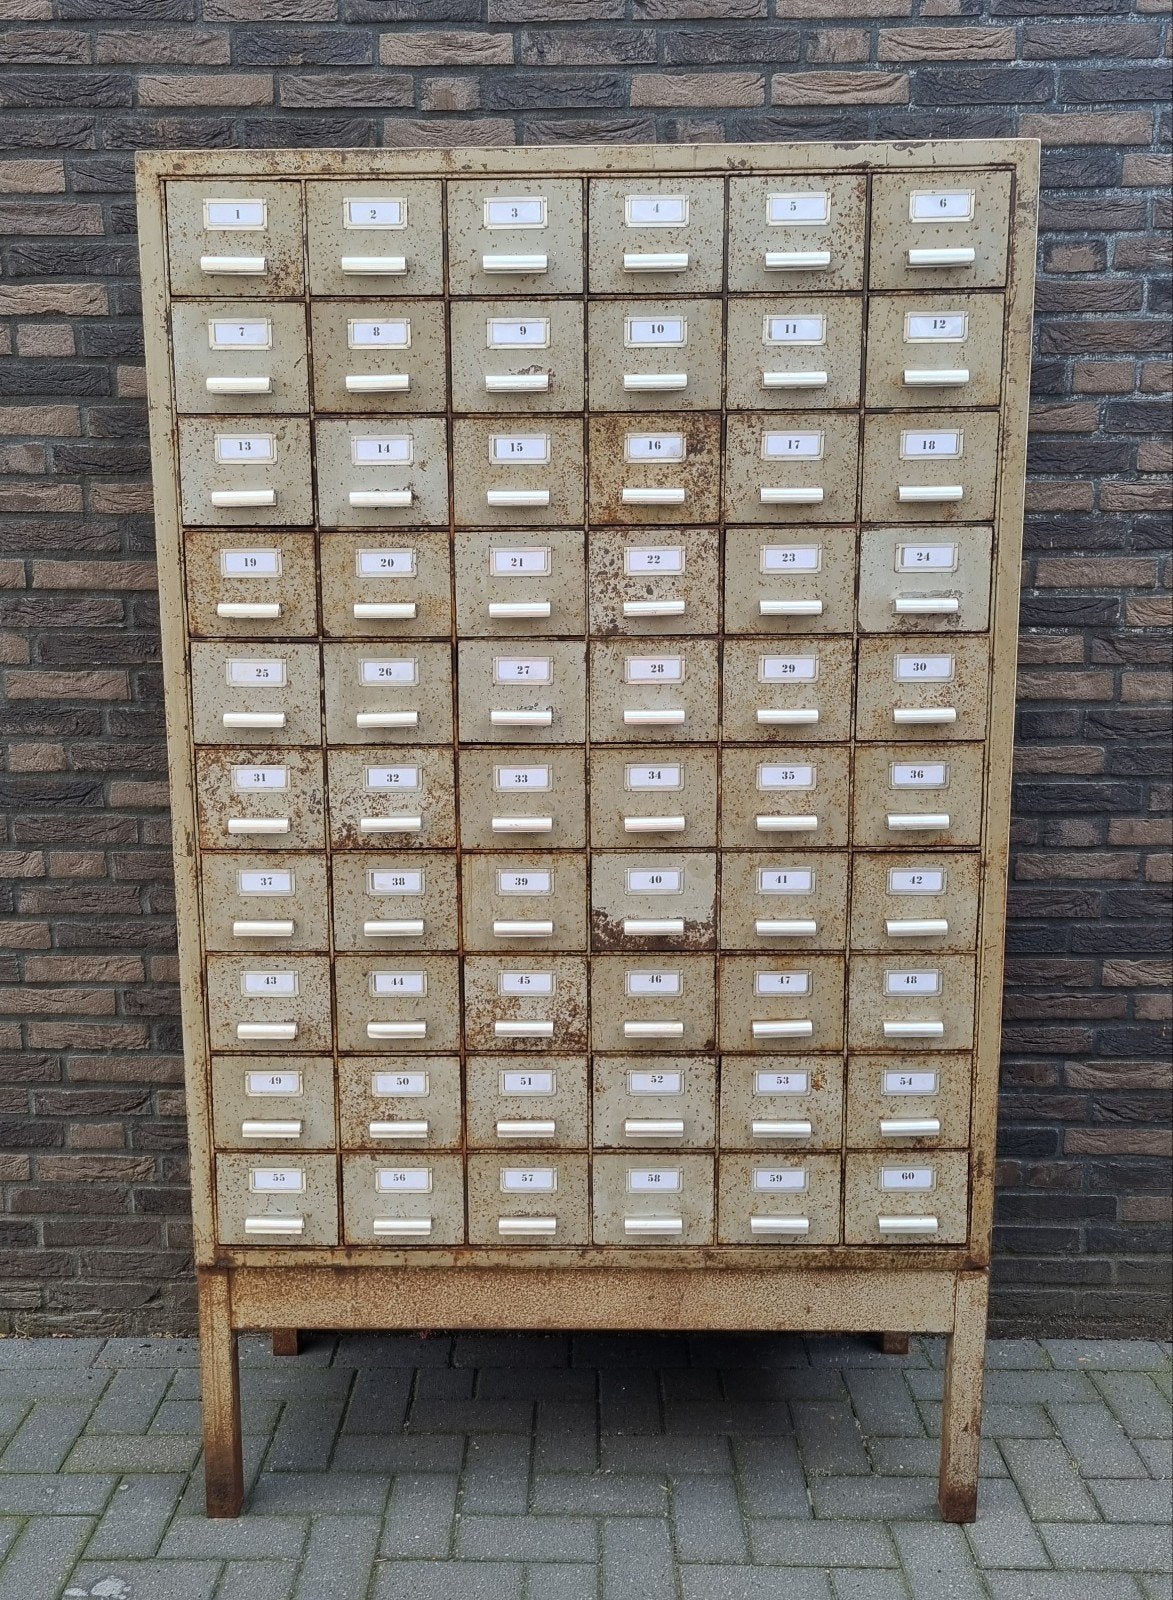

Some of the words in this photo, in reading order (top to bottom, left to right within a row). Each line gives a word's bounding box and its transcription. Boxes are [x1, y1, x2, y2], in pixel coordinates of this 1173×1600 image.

[790, 201, 797, 211] 5
[939, 198, 947, 208] 6
[235, 209, 242, 220] 1
[369, 209, 377, 220] 2
[511, 207, 519, 218] 3
[651, 324, 665, 334] 10
[785, 323, 797, 334] 11
[932, 319, 947, 330] 12
[238, 326, 245, 337] 7
[373, 326, 381, 337] 8
[519, 325, 527, 336] 9
[238, 441, 252, 451] 13
[377, 443, 391, 454] 14
[510, 442, 524, 453] 15
[648, 440, 662, 451] 16
[788, 439, 801, 450] 17
[922, 440, 936, 450] 18
[646, 554, 661, 565] 22
[781, 552, 796, 563] 23
[916, 551, 931, 562] 24
[244, 557, 257, 567] 19
[380, 558, 395, 568] 20
[510, 557, 524, 568] 21
[378, 667, 393, 677] 26
[516, 665, 531, 675] 27
[650, 663, 665, 674] 28
[781, 663, 796, 674] 29
[912, 662, 927, 672] 30
[255, 668, 270, 678] 25
[253, 772, 266, 783] 31
[386, 773, 400, 783] 32
[514, 774, 529, 784] 33
[648, 770, 662, 780] 34
[781, 770, 795, 780] 35
[909, 769, 925, 779] 36
[260, 876, 273, 886] 37
[391, 877, 406, 886] 38
[514, 877, 529, 886] 39
[648, 875, 663, 884] 40
[775, 874, 788, 884] 41
[909, 875, 923, 885] 42
[263, 976, 277, 985] 43
[390, 977, 404, 986] 44
[517, 975, 531, 985] 45
[648, 975, 662, 984] 46
[777, 976, 790, 985] 47
[903, 975, 918, 984] 48
[268, 1076, 282, 1085] 49
[396, 1077, 410, 1086] 50
[520, 1076, 532, 1086] 51
[650, 1075, 664, 1084] 52
[776, 1076, 790, 1085] 53
[899, 1075, 913, 1086] 54
[272, 1173, 286, 1182] 55
[392, 1173, 406, 1182] 56
[521, 1173, 534, 1183] 57
[647, 1173, 661, 1183] 58
[769, 1173, 783, 1183] 59
[901, 1172, 915, 1181] 60
